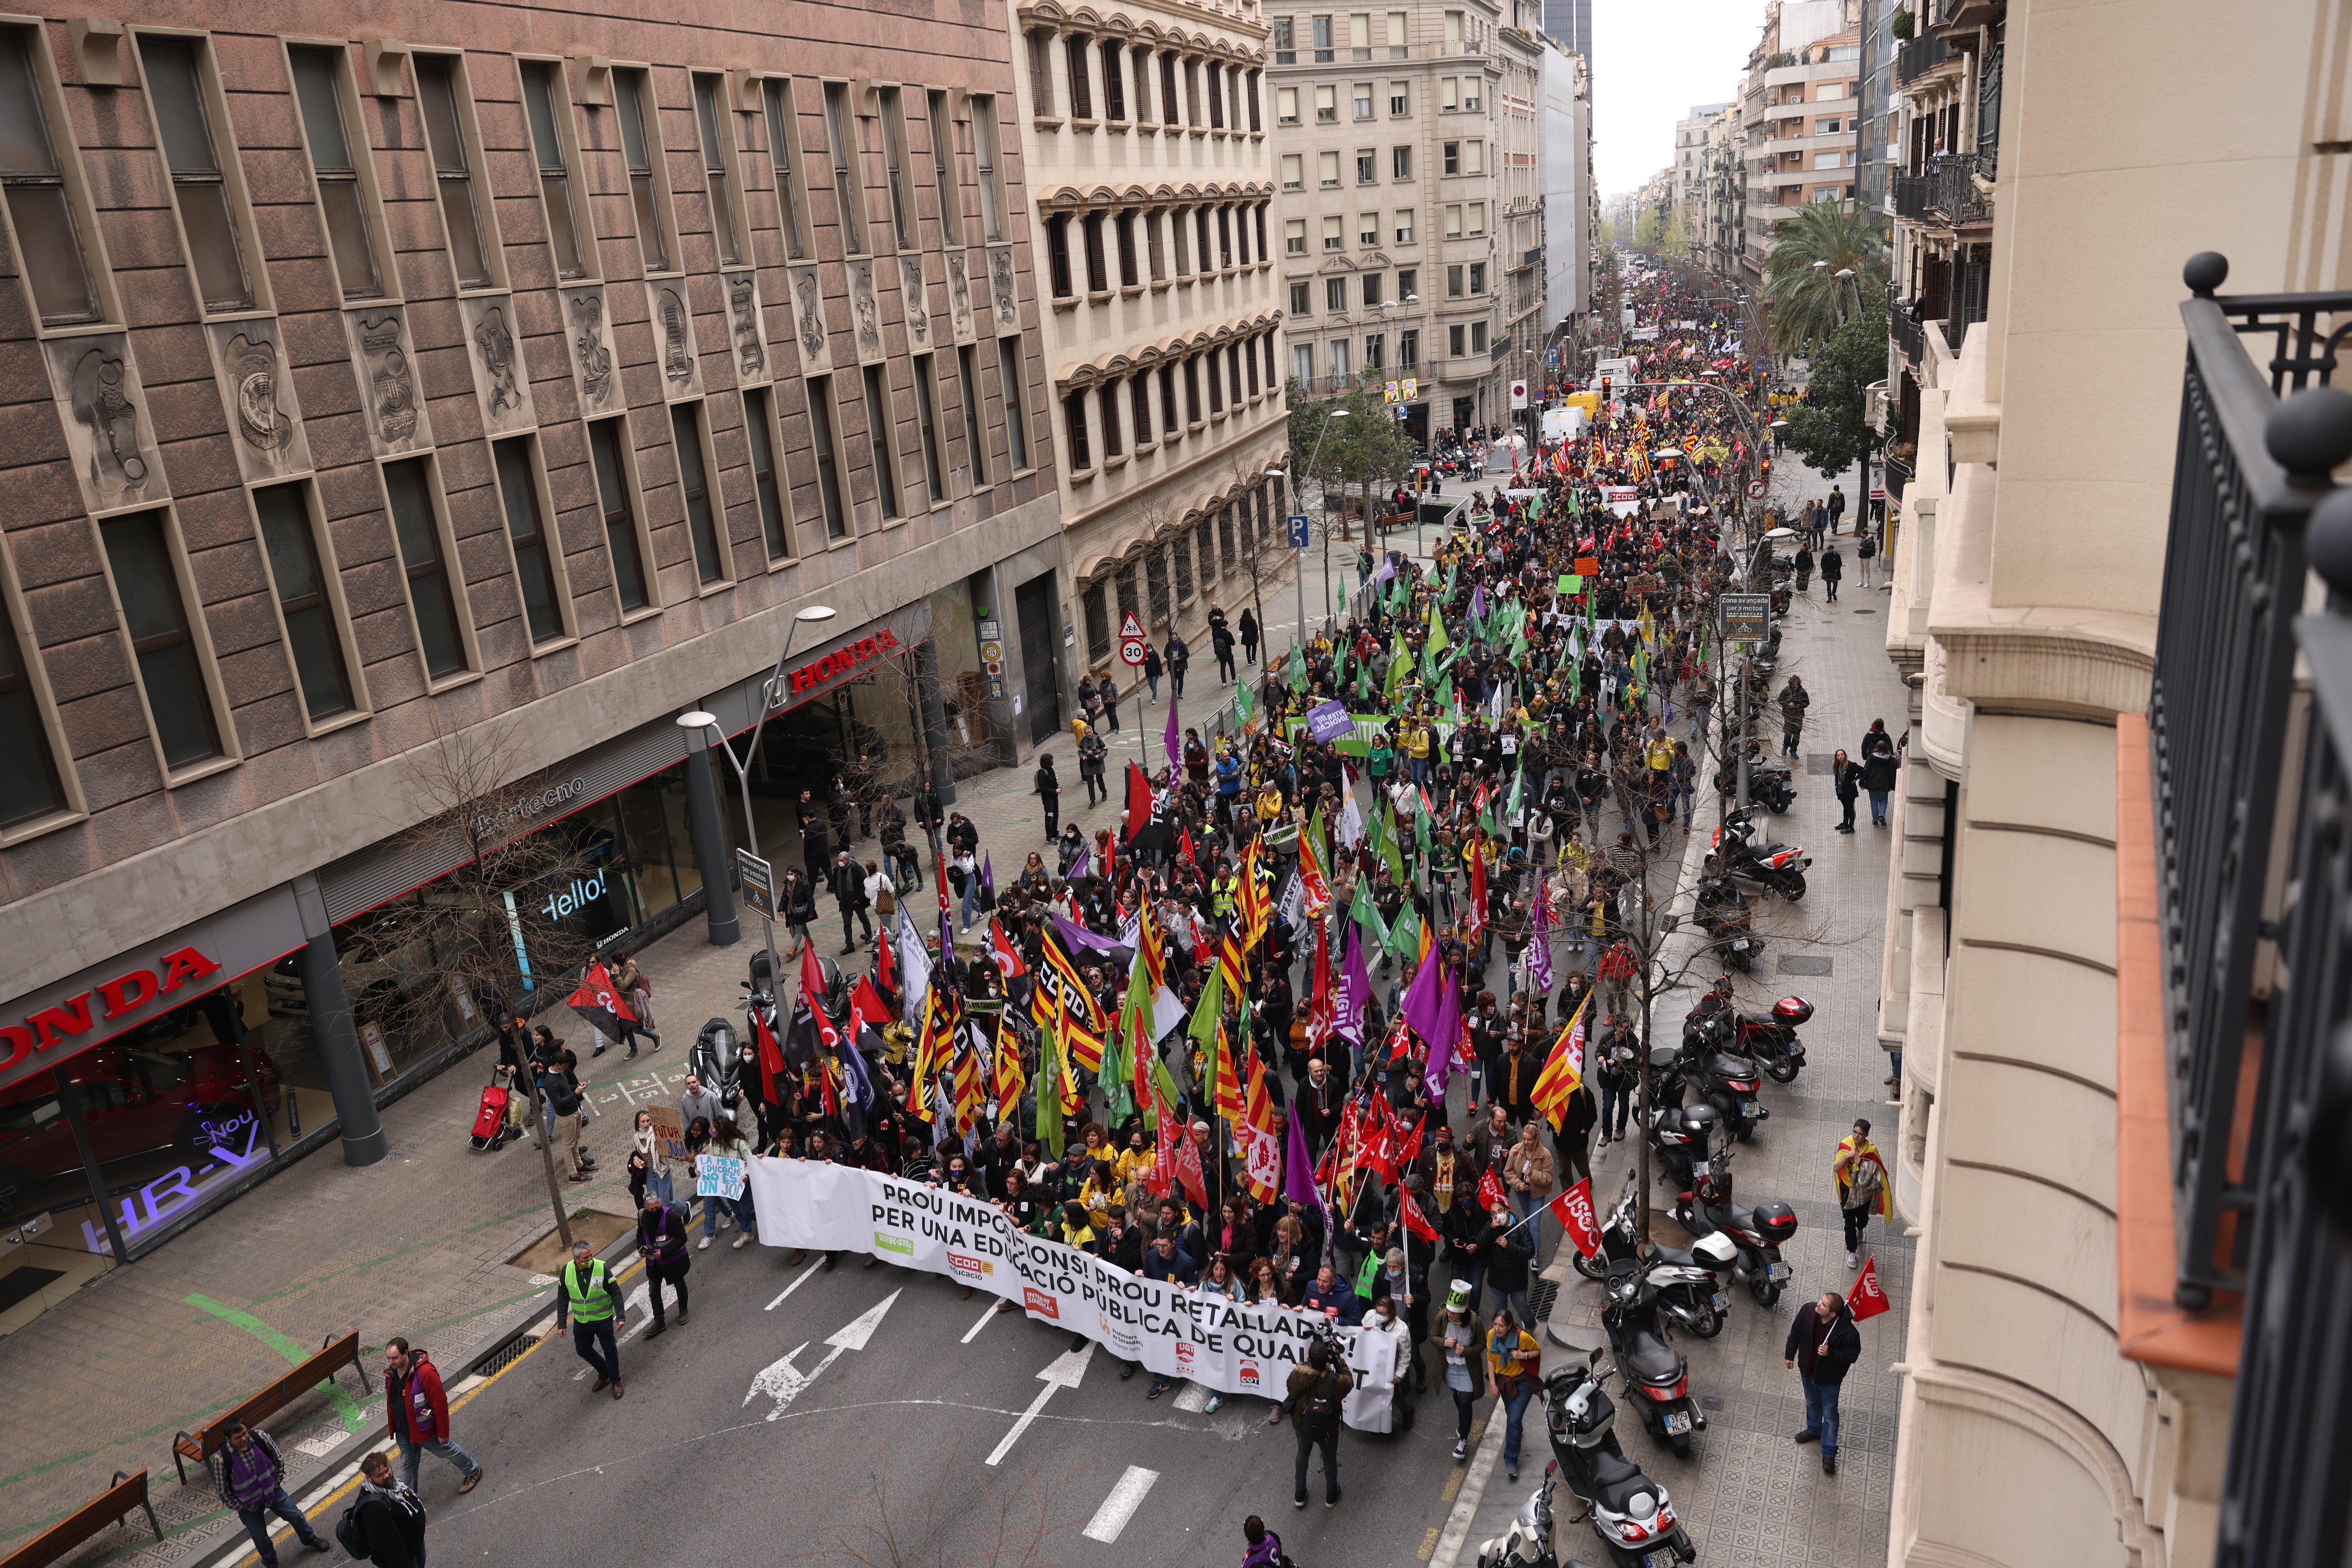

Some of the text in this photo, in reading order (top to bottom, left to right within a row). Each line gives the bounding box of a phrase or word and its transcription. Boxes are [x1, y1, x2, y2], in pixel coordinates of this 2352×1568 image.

[1549, 349, 1557, 363] P
[1291, 519, 1303, 537] P
[1125, 647, 1141, 658] 30
[788, 628, 899, 696] HONDA
[1279, 826, 1297, 839] CAMBRAY
[737, 853, 768, 874] Zona avançada
[752, 871, 766, 882] motos
[1281, 874, 1299, 916] WANTE
[602, 927, 630, 945] HONDA
[0, 946, 222, 1072] ONDA
[650, 1107, 668, 1117] AMB EL
[651, 1116, 670, 1125] NOSTRE
[653, 1125, 681, 1139] FUTUR
[656, 1139, 663, 1148] NO
[667, 1139, 687, 1157] JUGA
[700, 1155, 740, 1169] LA MEVA
[702, 1172, 719, 1181] NO
[81, 1120, 260, 1253] HR-V
[699, 1181, 743, 1200] UN JOC
[883, 1183, 942, 1215] PROU
[949, 1201, 1089, 1279] IMPOSICIONS!
[1095, 1266, 1160, 1307] PROU
[948, 1254, 980, 1270] CCOO
[1773, 1263, 1787, 1271] 2268
[872, 1204, 915, 1231] PER
[922, 1216, 967, 1248] UNA
[974, 1232, 1075, 1294] EDUCACIÓ
[1082, 1283, 1182, 1338] PÚBLICA
[1191, 1323, 1223, 1353] DE
[950, 1265, 982, 1280] educació
[1774, 1270, 1785, 1278] FRD
[1027, 1292, 1044, 1302] INTER
[1715, 1291, 1726, 1302] 0072
[1027, 1297, 1055, 1312] SINDICAL
[1717, 1299, 1727, 1310] KDM
[1112, 1329, 1137, 1339] Professors
[1118, 1337, 1144, 1347] Secundària
[1179, 1343, 1194, 1353] UGT
[1241, 1376, 1259, 1385] CGT
[1669, 1412, 1688, 1424] 3129
[1672, 1421, 1687, 1432] HLN
[1650, 1549, 1670, 1563] 5203
